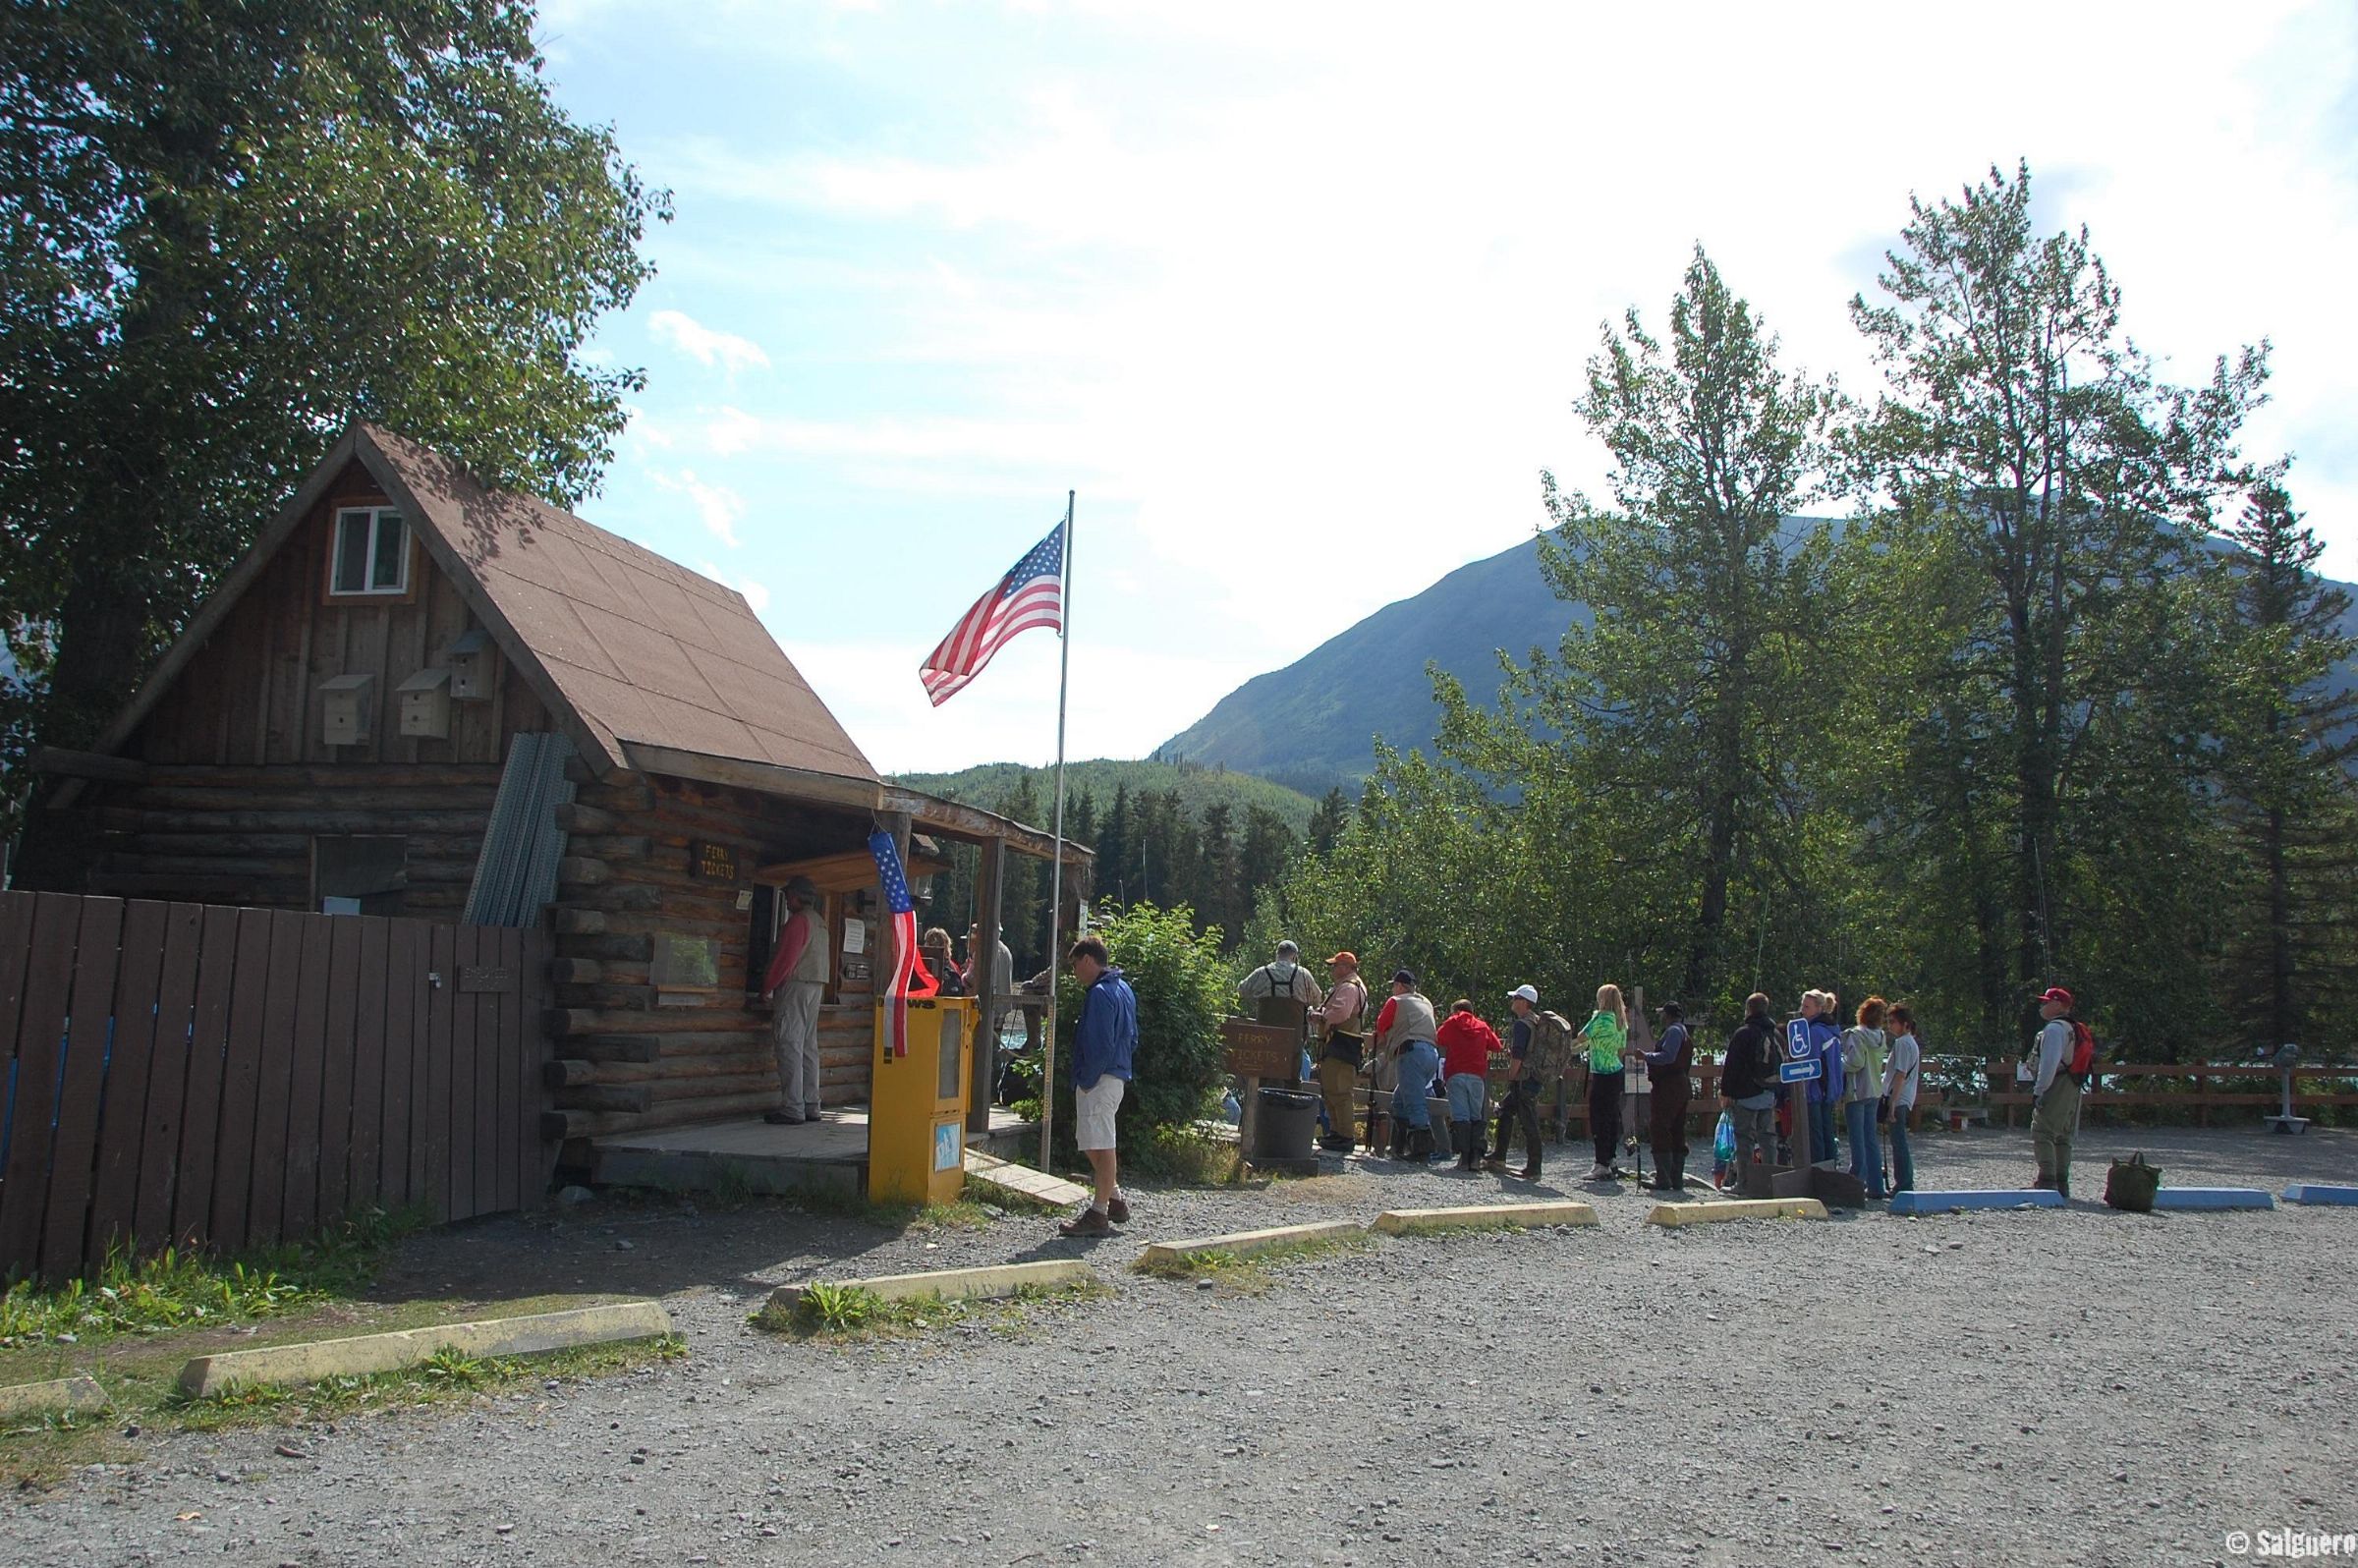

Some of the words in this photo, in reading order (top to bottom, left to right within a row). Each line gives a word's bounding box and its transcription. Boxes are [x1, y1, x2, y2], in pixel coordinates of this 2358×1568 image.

[705, 844, 730, 862] FERRY
[701, 860, 735, 880] TICKETS
[878, 997, 936, 1009] NWS
[1237, 1033, 1272, 1045] FERRY
[1232, 1048, 1279, 1063] TICKETS
[1487, 1050, 1507, 1061] RUSS
